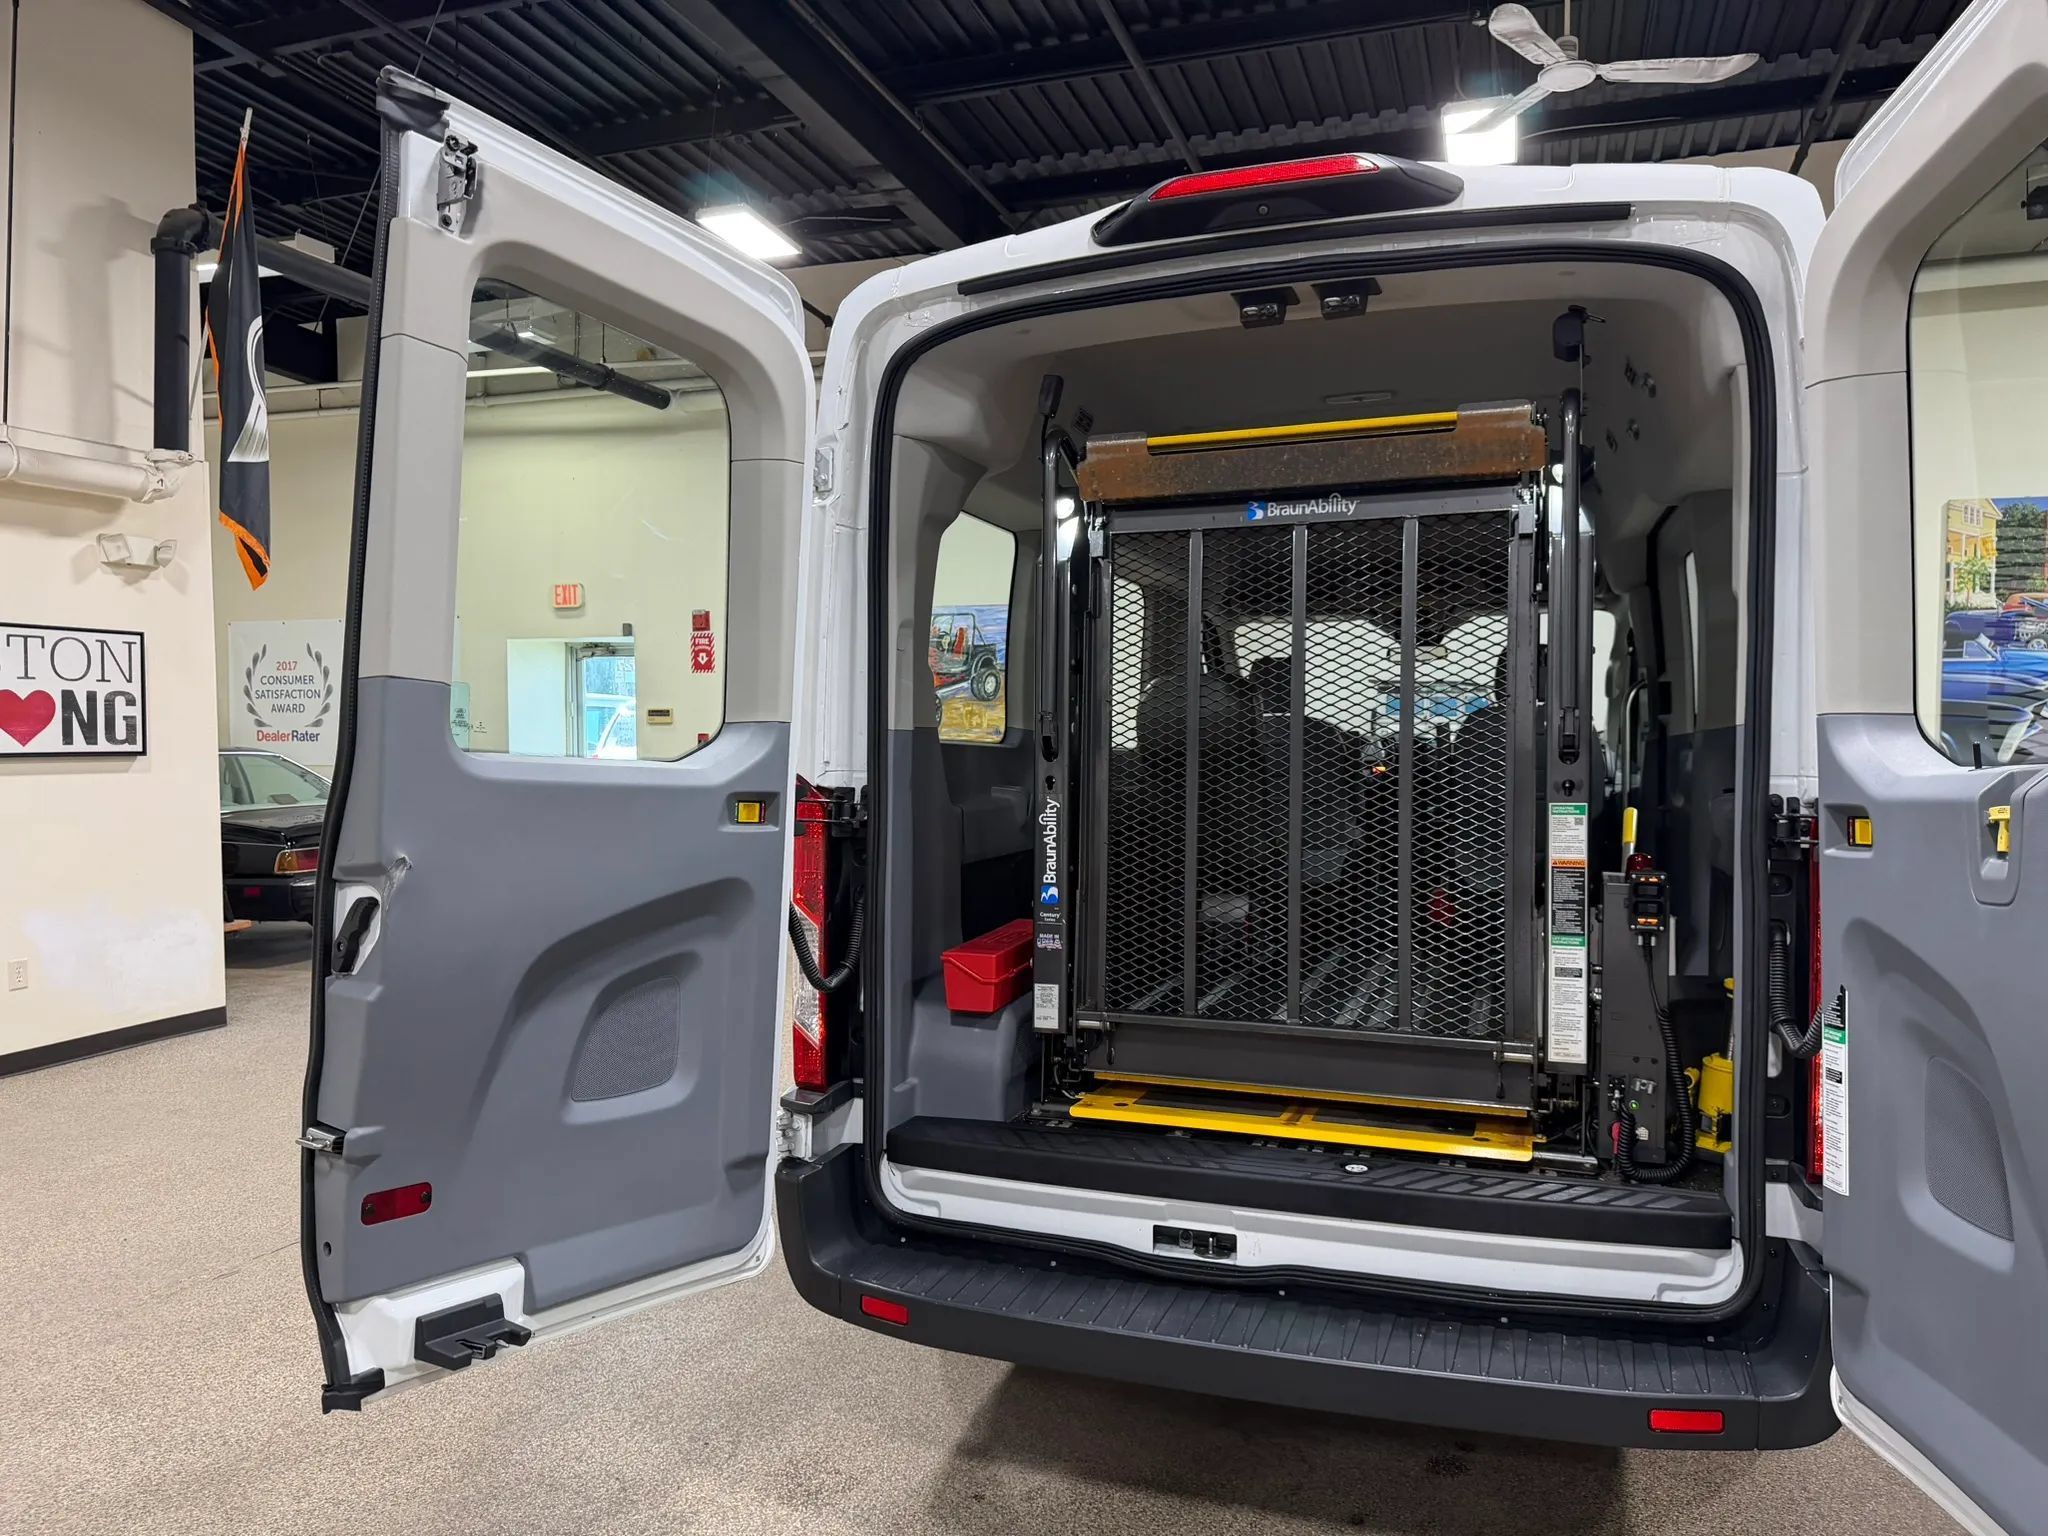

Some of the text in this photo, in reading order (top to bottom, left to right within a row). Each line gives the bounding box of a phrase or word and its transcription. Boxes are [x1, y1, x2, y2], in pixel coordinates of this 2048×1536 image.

[1267, 493, 1357, 517] BraunAbility
[554, 584, 578, 606] EXIT
[0, 634, 137, 683] TON
[276, 661, 297, 671] 2017
[260, 675, 315, 685] CONSUMER
[255, 689, 321, 699] SATISFACTION
[271, 703, 305, 713] AWARD
[1039, 798, 1060, 883] BraunAbility
